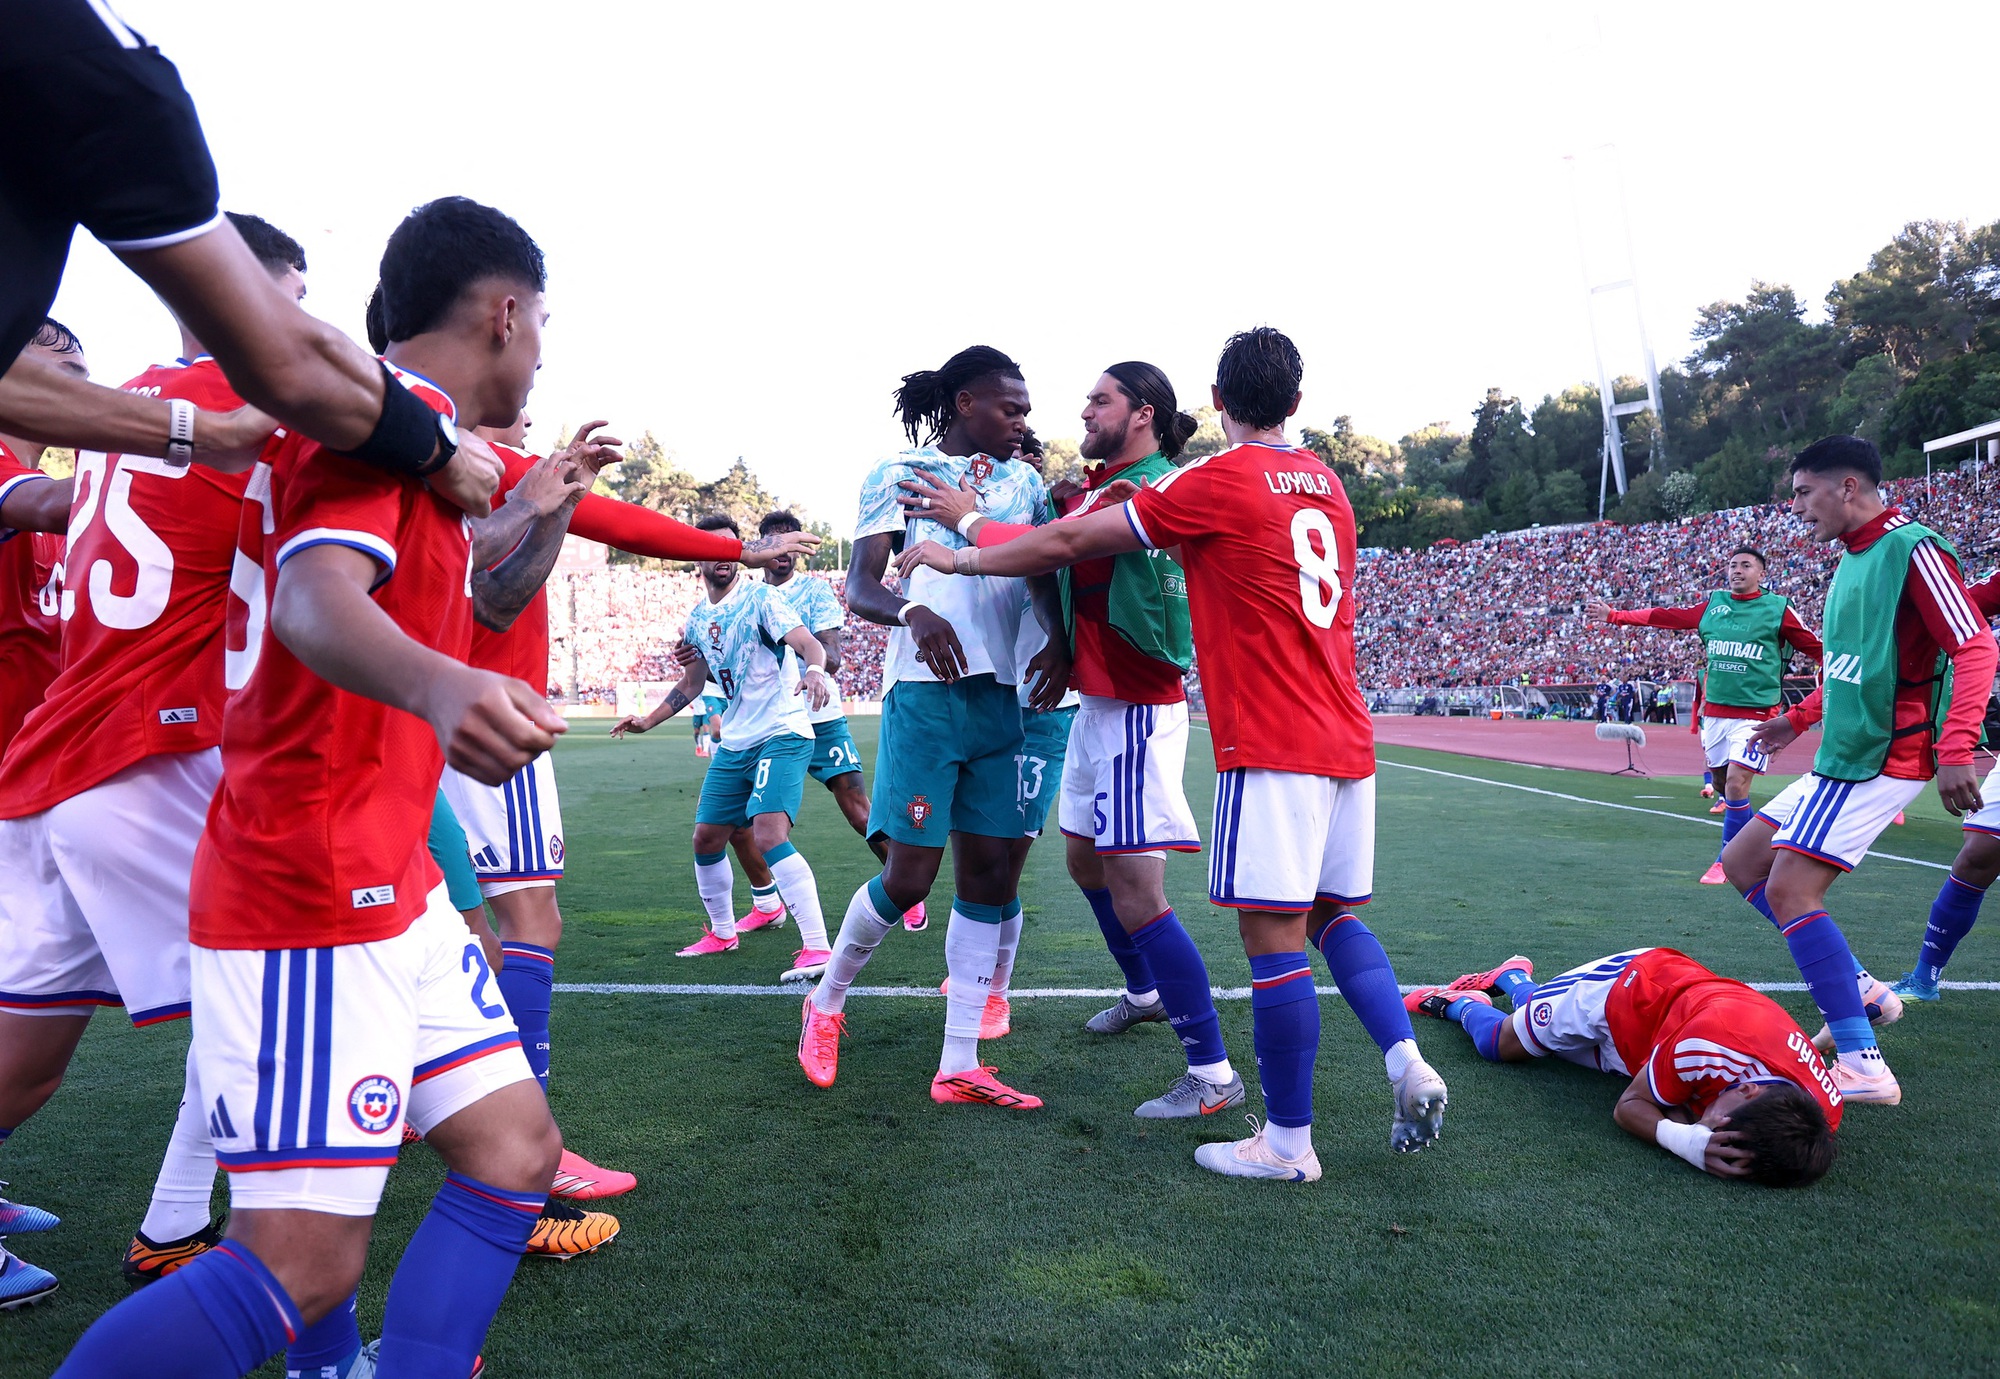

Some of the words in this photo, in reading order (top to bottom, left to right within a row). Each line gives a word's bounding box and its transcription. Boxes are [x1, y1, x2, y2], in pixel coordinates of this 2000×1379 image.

[1264, 471, 1332, 496] LOYOLA
[61, 449, 191, 630] 25
[1290, 508, 1343, 629] 8
[1710, 604, 1731, 616] UEFA
[1708, 640, 1764, 660] #FOOTBALL
[1718, 662, 1748, 673] RESPECT
[719, 668, 734, 700] 8
[828, 741, 858, 767] 24
[755, 758, 772, 790] 8
[1014, 754, 1047, 800] 13
[462, 943, 505, 1019] 2
